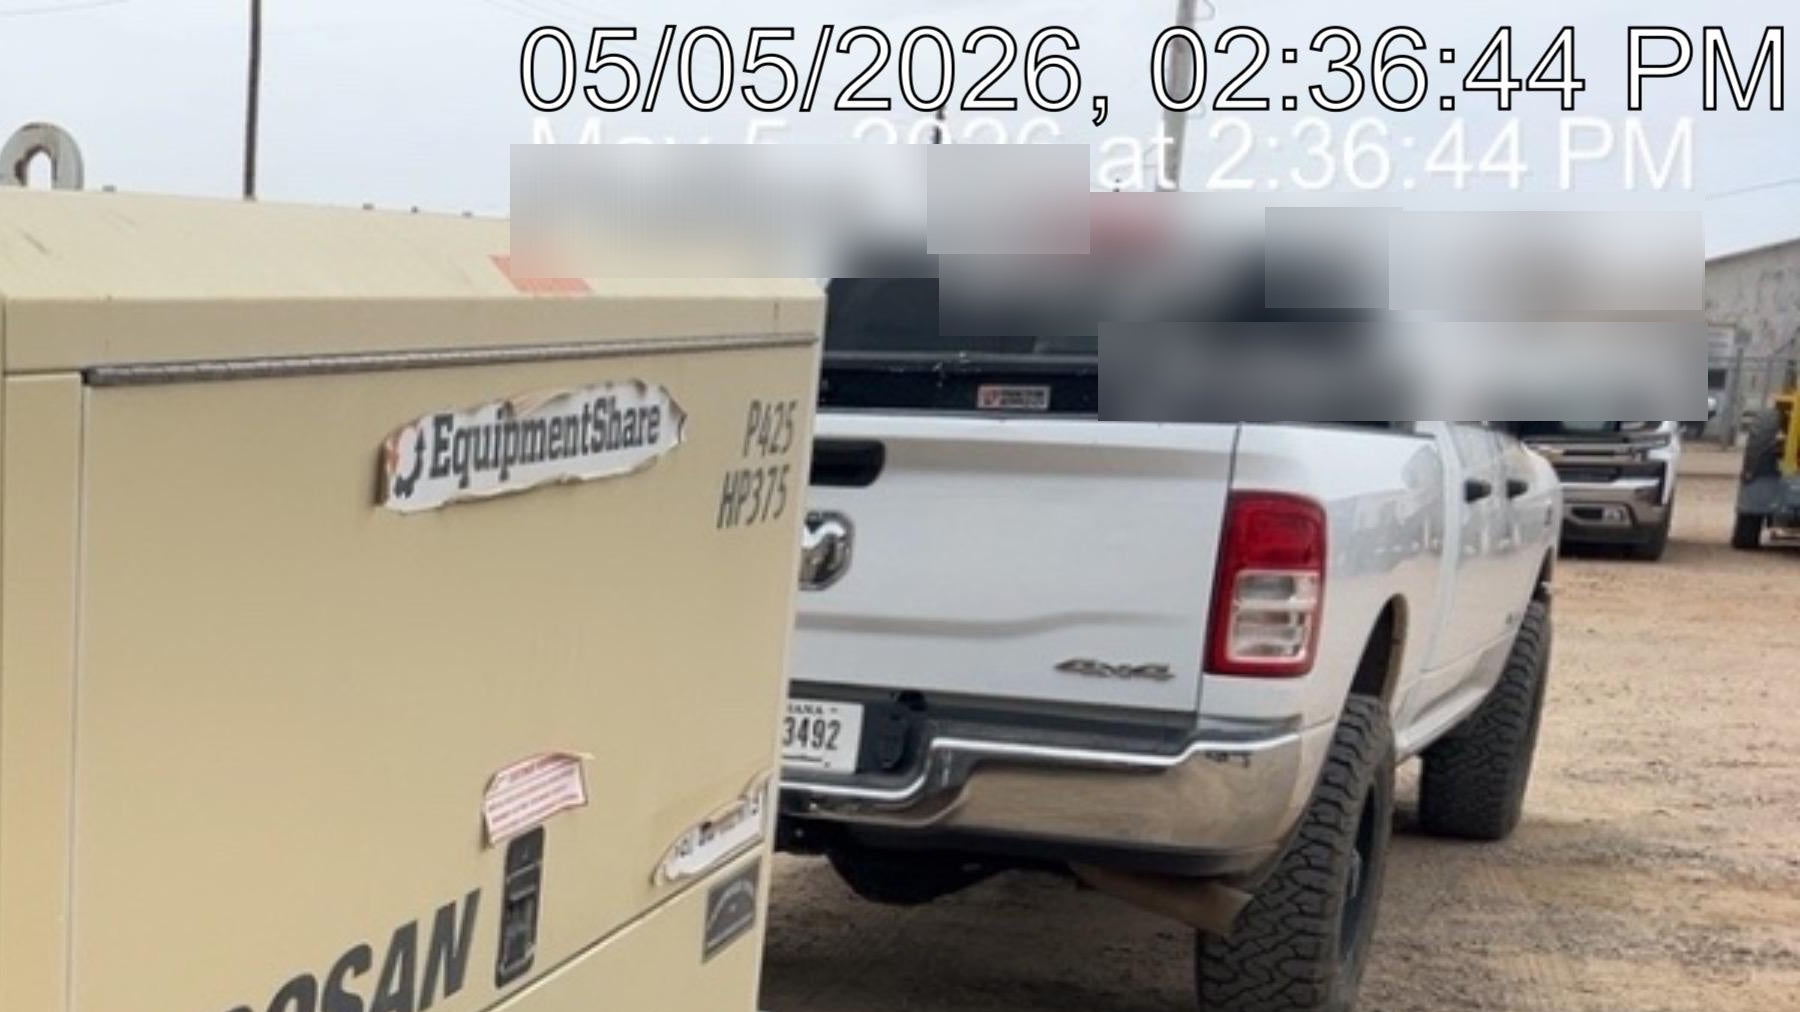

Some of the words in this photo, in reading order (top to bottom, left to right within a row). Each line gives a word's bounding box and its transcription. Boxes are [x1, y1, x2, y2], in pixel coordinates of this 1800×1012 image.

[428, 398, 661, 489] EquipmentShare
[742, 399, 799, 458] P425
[716, 464, 791, 529] HP375
